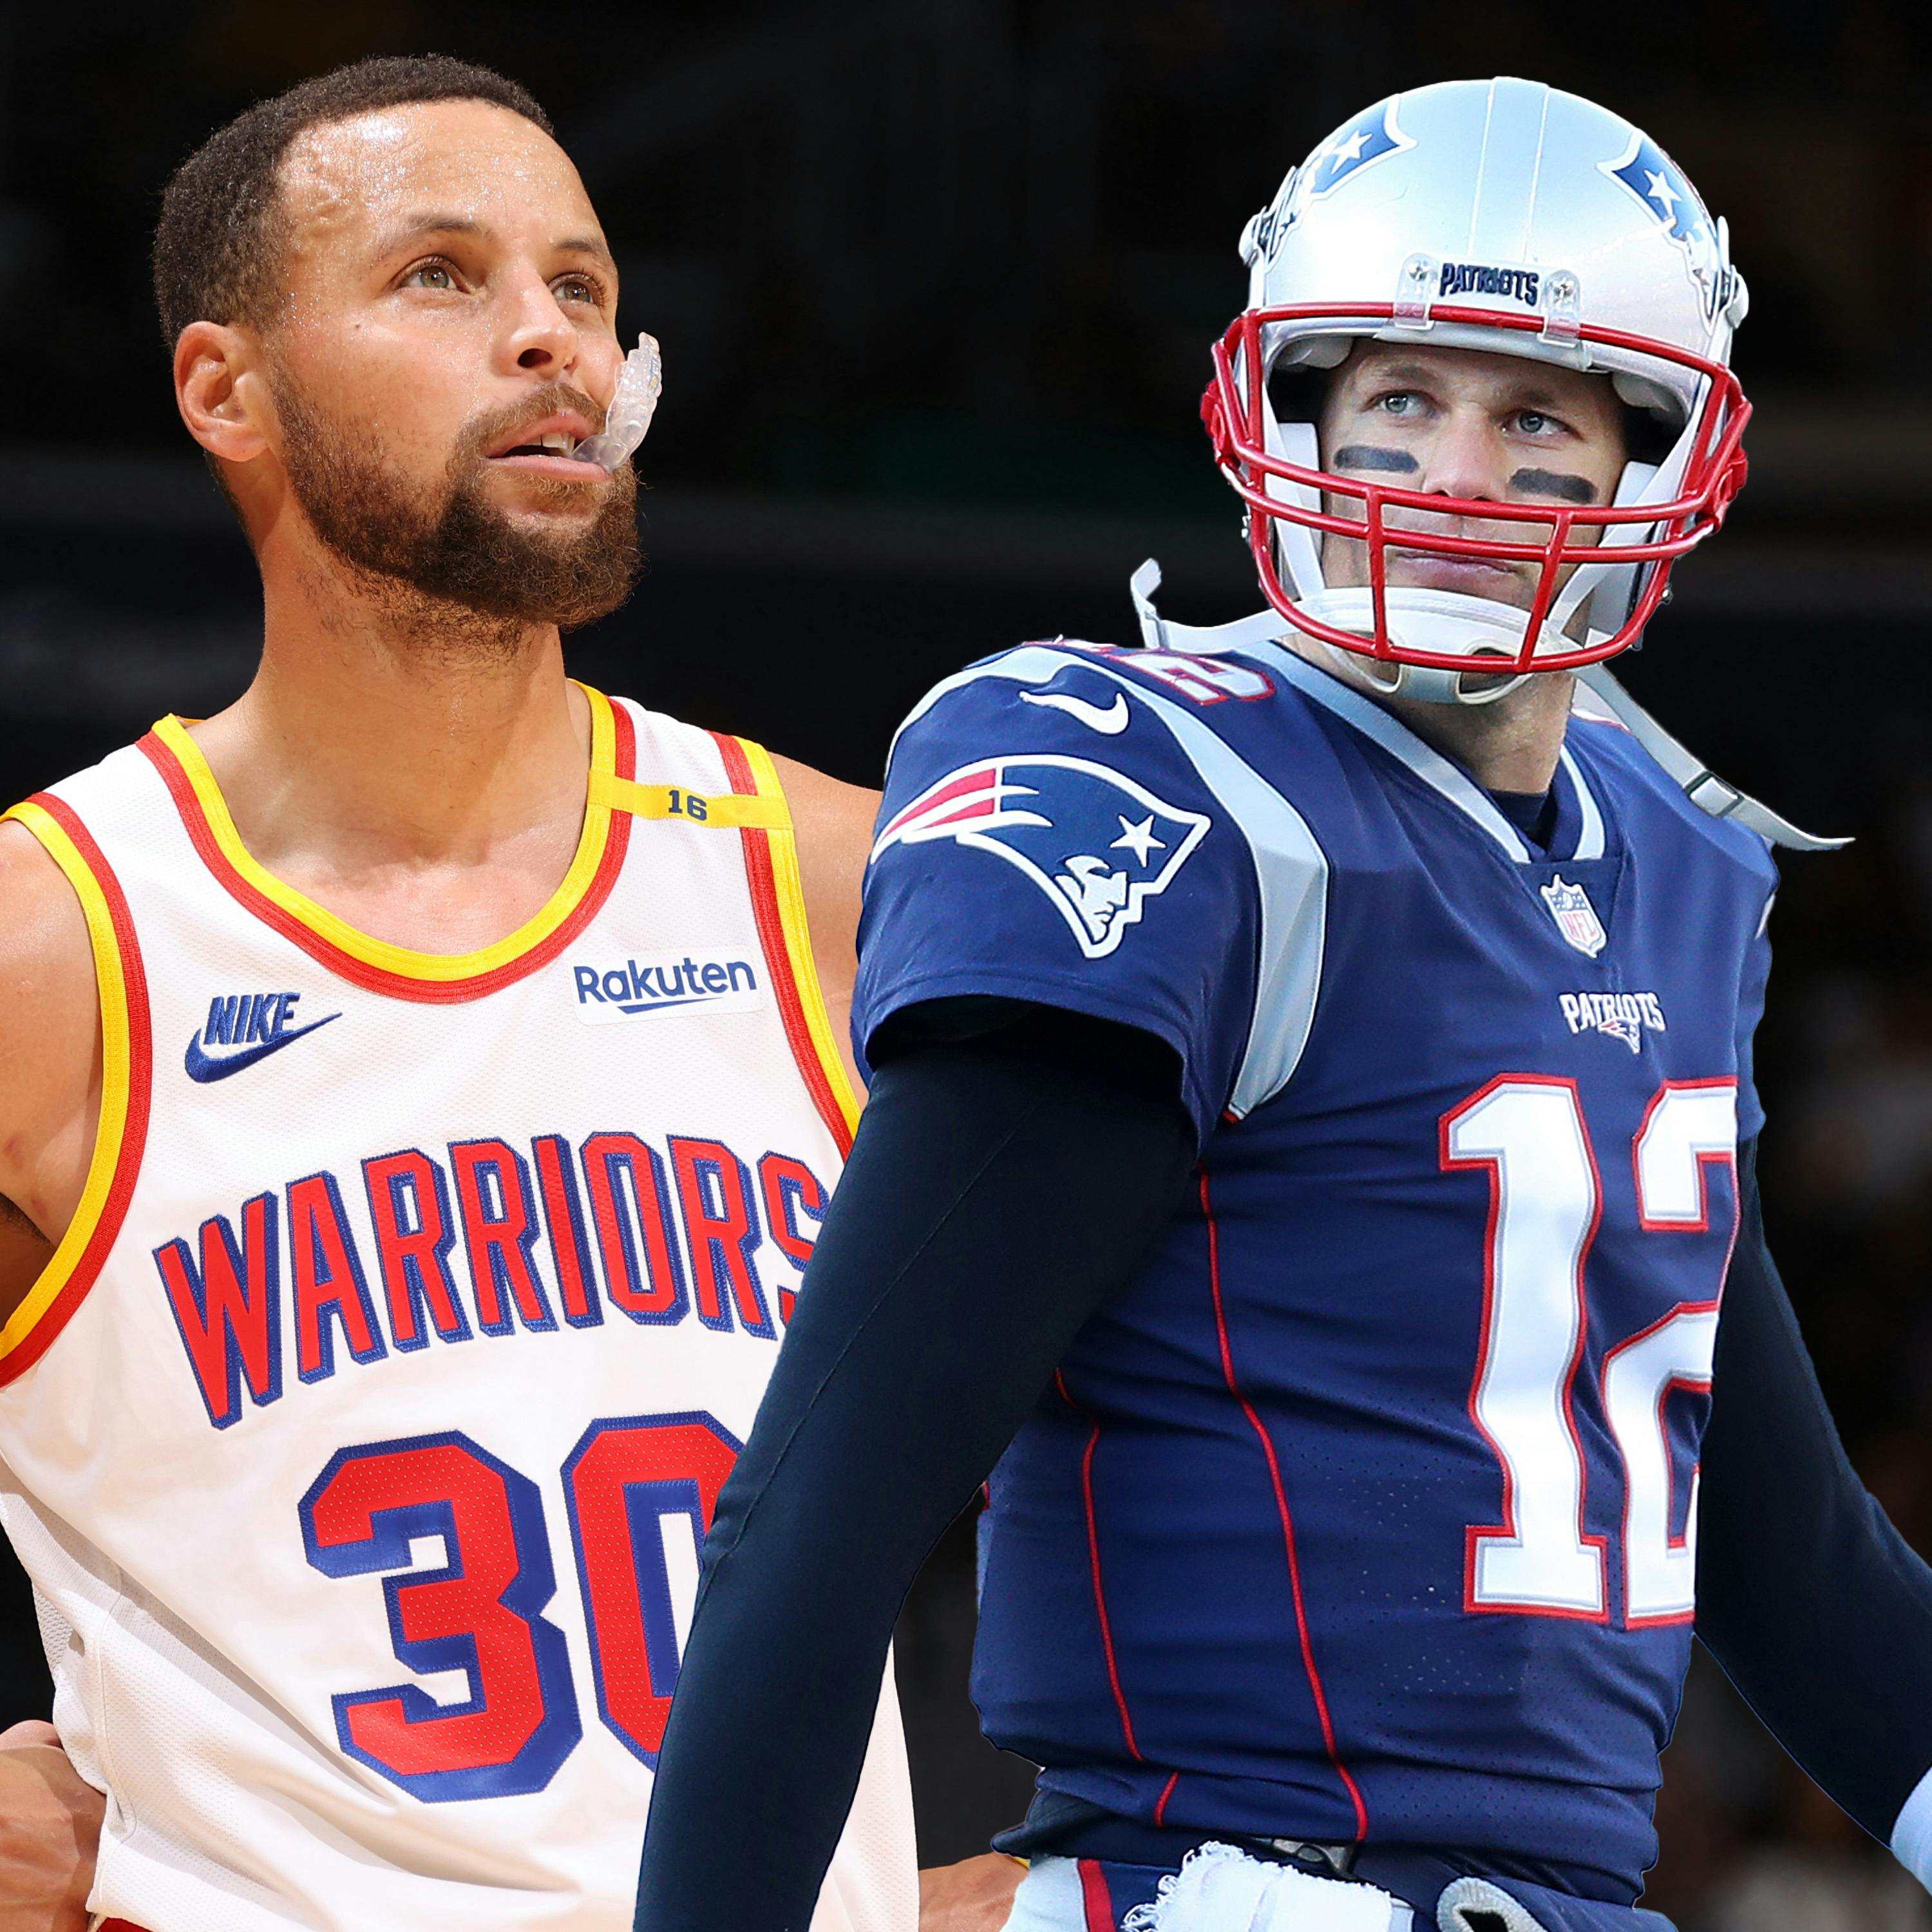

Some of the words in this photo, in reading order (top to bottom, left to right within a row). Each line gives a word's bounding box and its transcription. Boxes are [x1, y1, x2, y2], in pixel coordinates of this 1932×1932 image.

[1439, 263, 1539, 307] PATRIOTS
[668, 790, 708, 821] 16
[1561, 911, 1598, 942] NFL
[574, 958, 757, 1003] Rakuten
[203, 992, 301, 1045] NIKE
[1558, 992, 1666, 1034] PATRIOTS
[1438, 1072, 1741, 1630] 12
[298, 1409, 748, 1803] 30
